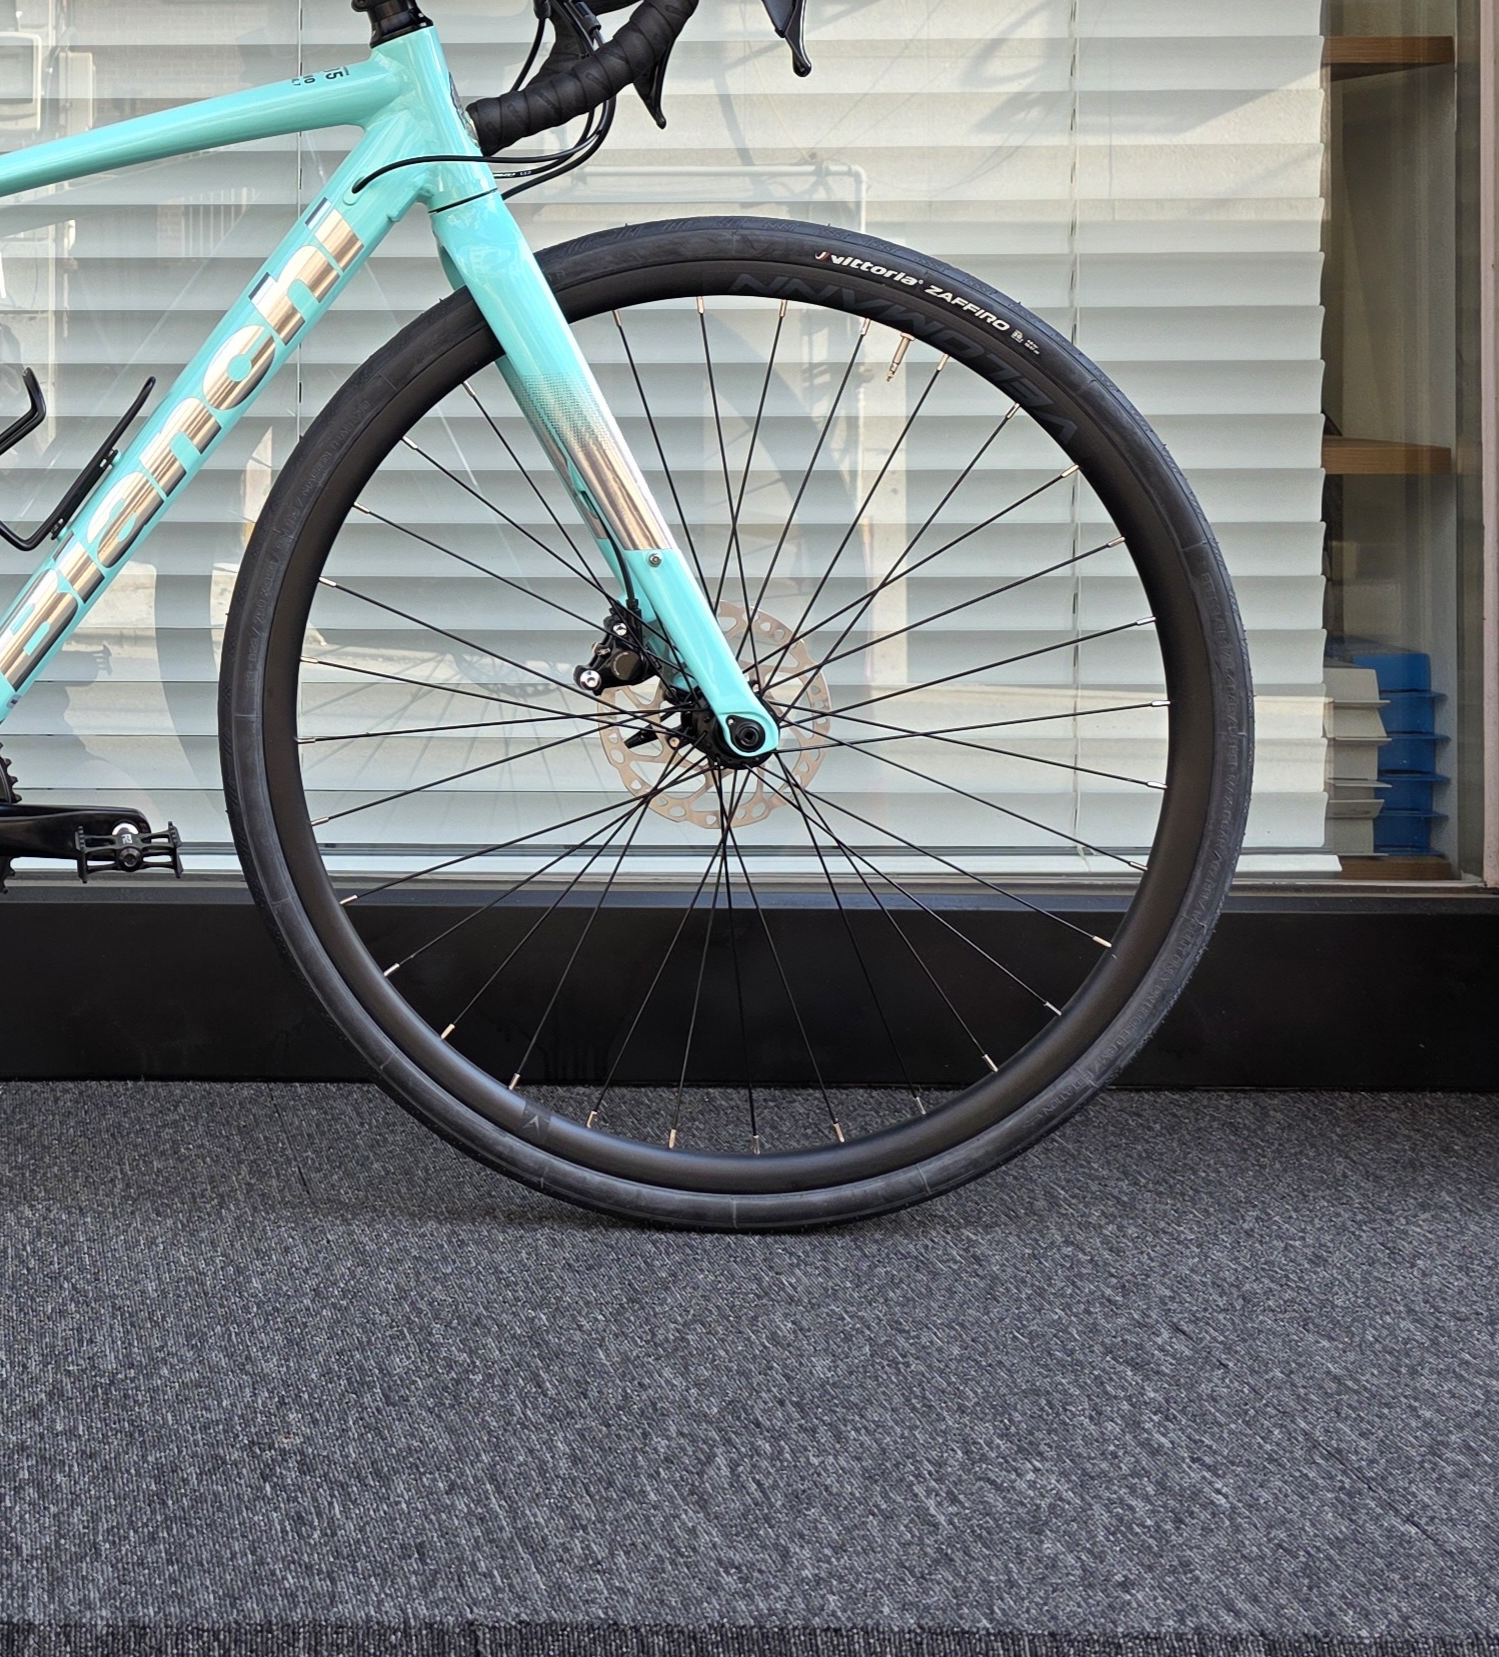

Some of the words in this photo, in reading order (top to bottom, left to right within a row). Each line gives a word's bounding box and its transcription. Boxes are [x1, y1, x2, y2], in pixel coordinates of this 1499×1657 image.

[830, 253, 919, 287] vittoria
[925, 284, 1010, 332] ZAFFIRO
[729, 273, 1077, 443] VELOMANN
